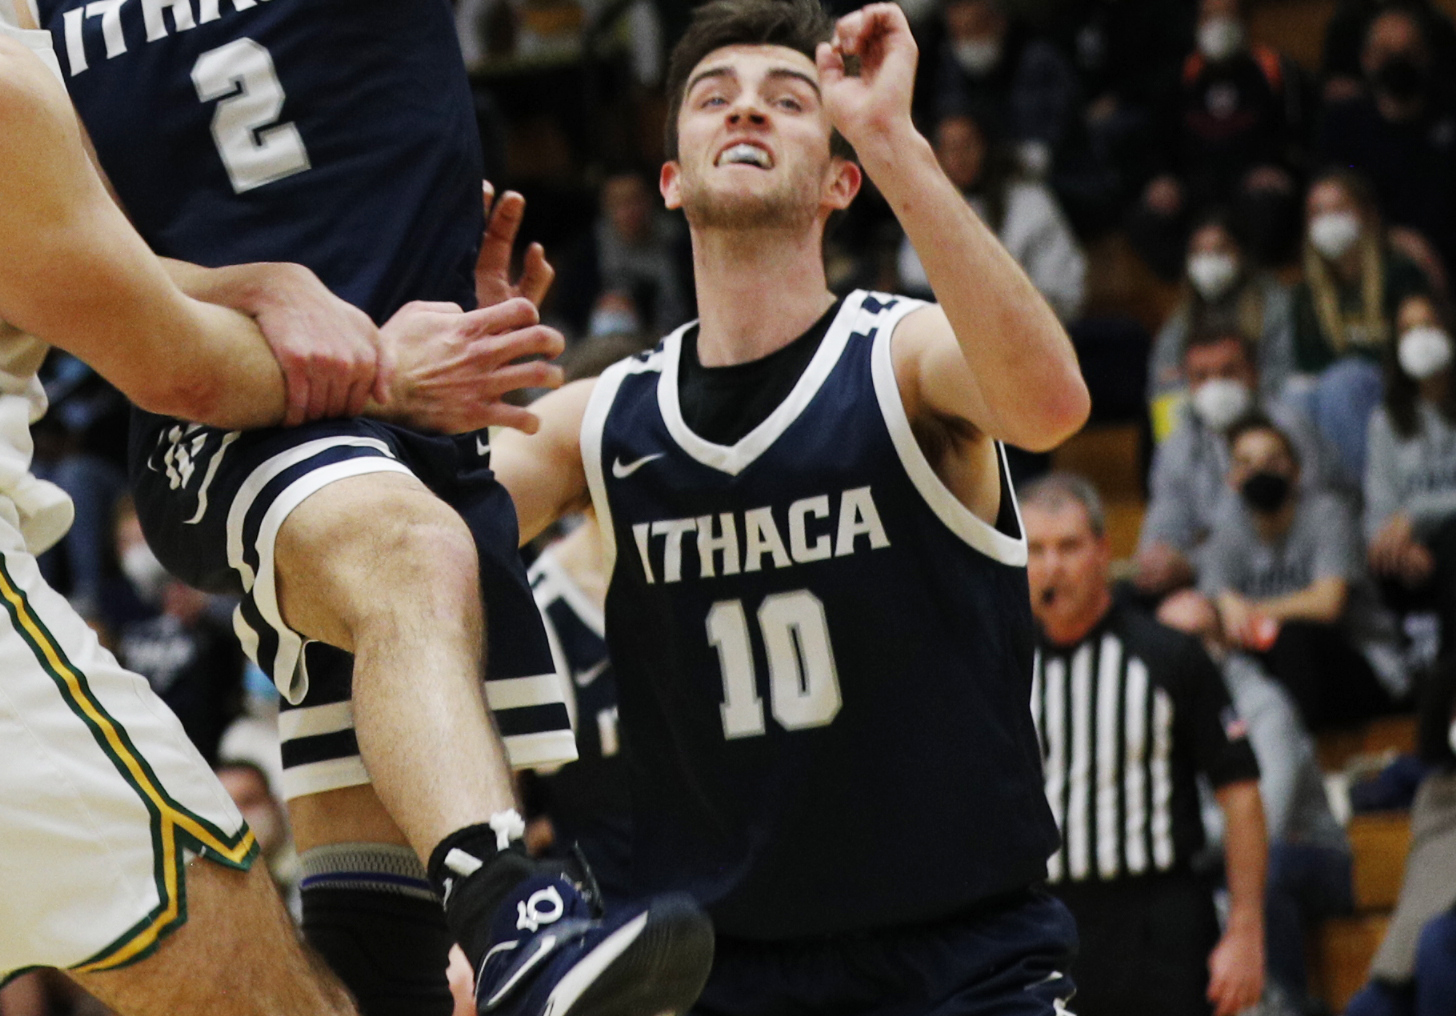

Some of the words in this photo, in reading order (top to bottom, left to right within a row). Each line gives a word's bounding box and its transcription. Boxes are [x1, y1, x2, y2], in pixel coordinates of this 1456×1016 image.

[189, 36, 312, 195] 2
[631, 485, 892, 585] ITHACA
[704, 588, 844, 741] 10
